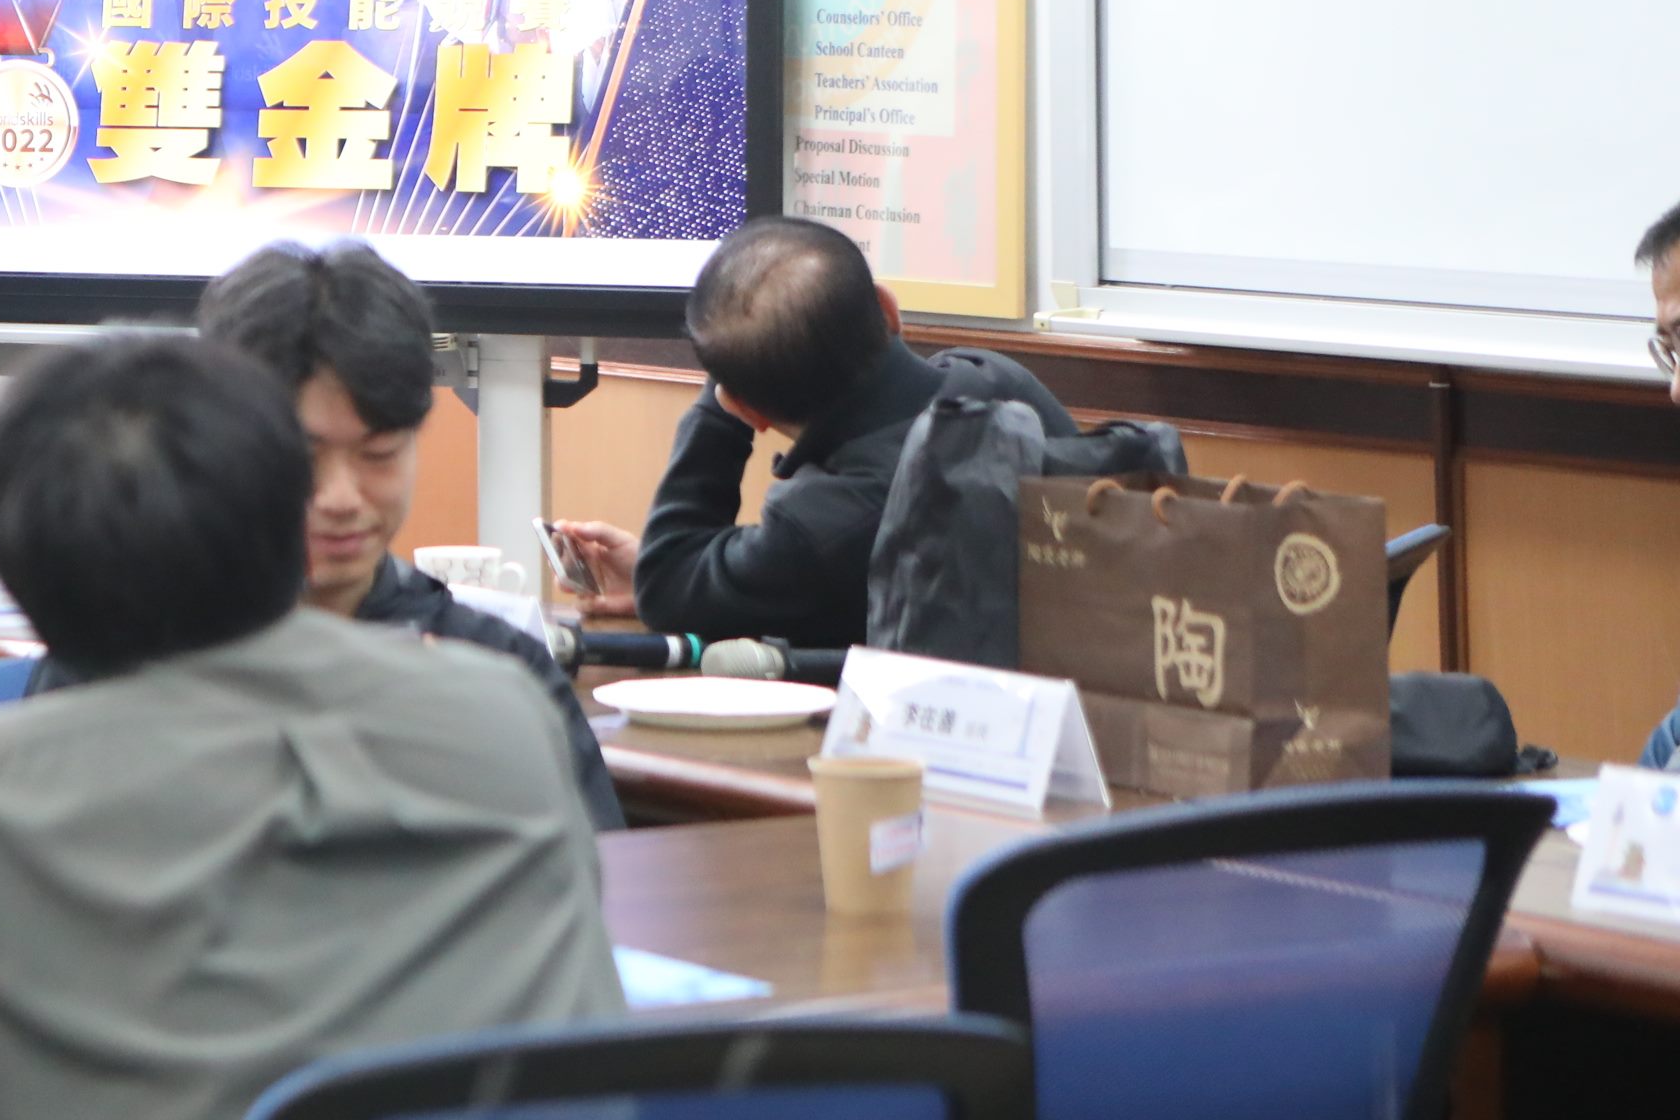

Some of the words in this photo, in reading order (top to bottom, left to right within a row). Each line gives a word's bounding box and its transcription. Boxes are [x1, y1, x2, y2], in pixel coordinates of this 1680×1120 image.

[888, 11, 923, 28] Office
[815, 41, 854, 57] School
[857, 43, 905, 59] Canteen
[871, 76, 939, 94] Association
[86, 40, 575, 193] 雙金牌
[880, 109, 916, 126] Office
[795, 136, 845, 157] Proposal
[849, 138, 910, 158] Discussion
[794, 168, 836, 189] Special
[839, 173, 880, 189] Motion
[793, 199, 852, 220] Chairman
[855, 205, 921, 225] Conclusion
[1152, 594, 1227, 708] 陶
